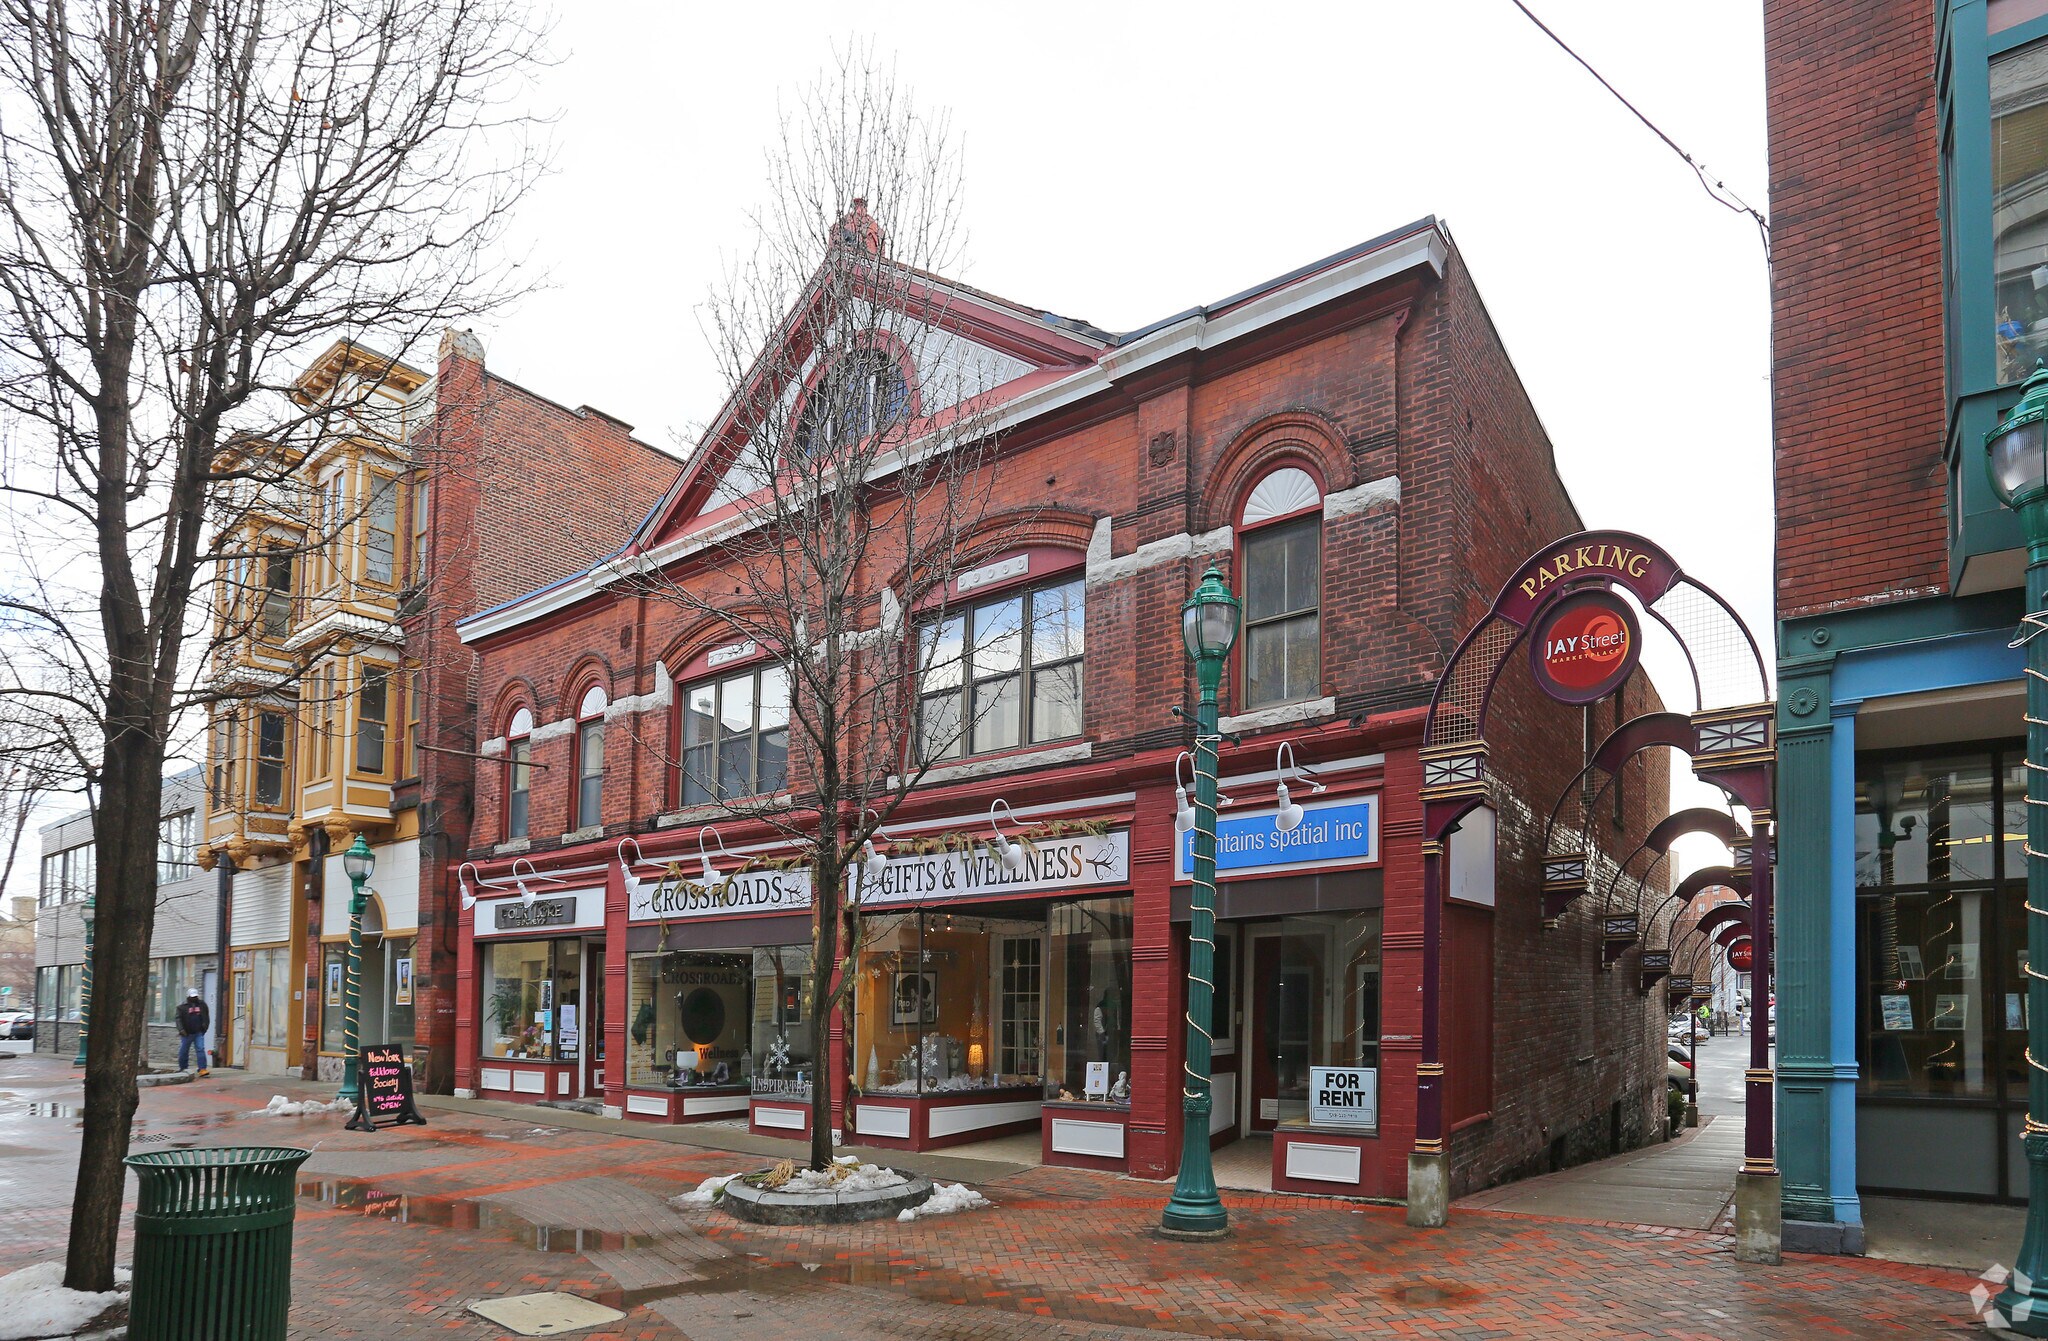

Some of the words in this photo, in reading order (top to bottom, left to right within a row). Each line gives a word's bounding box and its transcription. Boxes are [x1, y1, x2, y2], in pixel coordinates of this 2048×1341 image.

[1519, 544, 1652, 600] PARKING
[1546, 636, 1579, 660] JAY
[1581, 630, 1625, 650] Street
[1551, 648, 1621, 664] MARKETPLACE
[1187, 829, 1265, 858] fntains
[1269, 820, 1329, 852] spatial
[1334, 819, 1363, 842] inc
[881, 861, 936, 895] GIFTS
[942, 859, 956, 889] &
[367, 1051, 384, 1063] New
[1325, 1072, 1360, 1089] FOR
[1319, 1089, 1366, 1107] RENT
